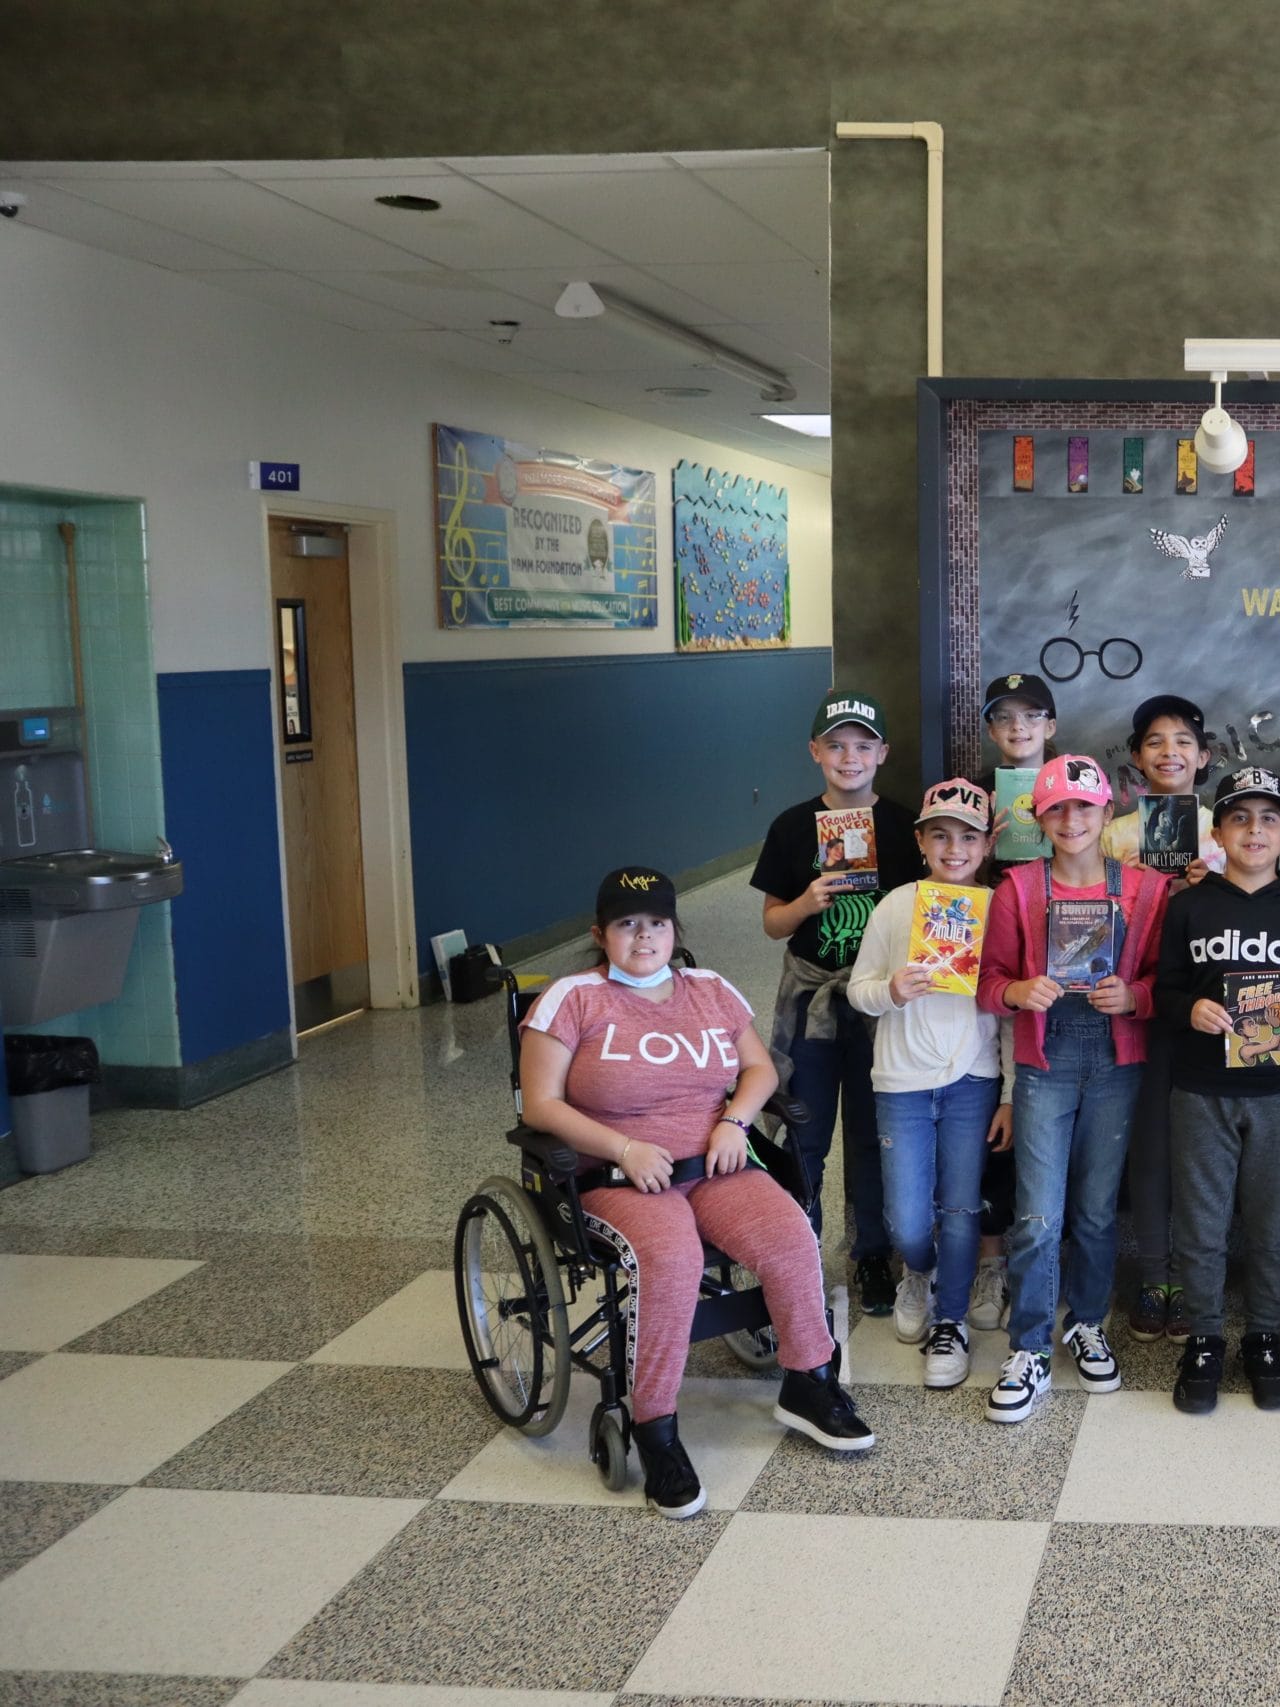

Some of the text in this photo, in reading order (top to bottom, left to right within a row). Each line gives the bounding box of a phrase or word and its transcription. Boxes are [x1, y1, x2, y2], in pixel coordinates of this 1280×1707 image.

[267, 470, 292, 483] 401
[512, 507, 582, 535] RECOGNIZED
[535, 537, 559, 552] BY THE
[536, 560, 582, 576] FOUNDATION
[493, 597, 513, 611] BEST
[826, 700, 876, 720] IRELAND
[820, 818, 873, 846] MAKER
[1143, 851, 1193, 867] LONELY GHOST
[1055, 904, 1109, 915] I SURVIVED
[1237, 981, 1274, 1003] FREE
[600, 1023, 738, 1069] LOVE
